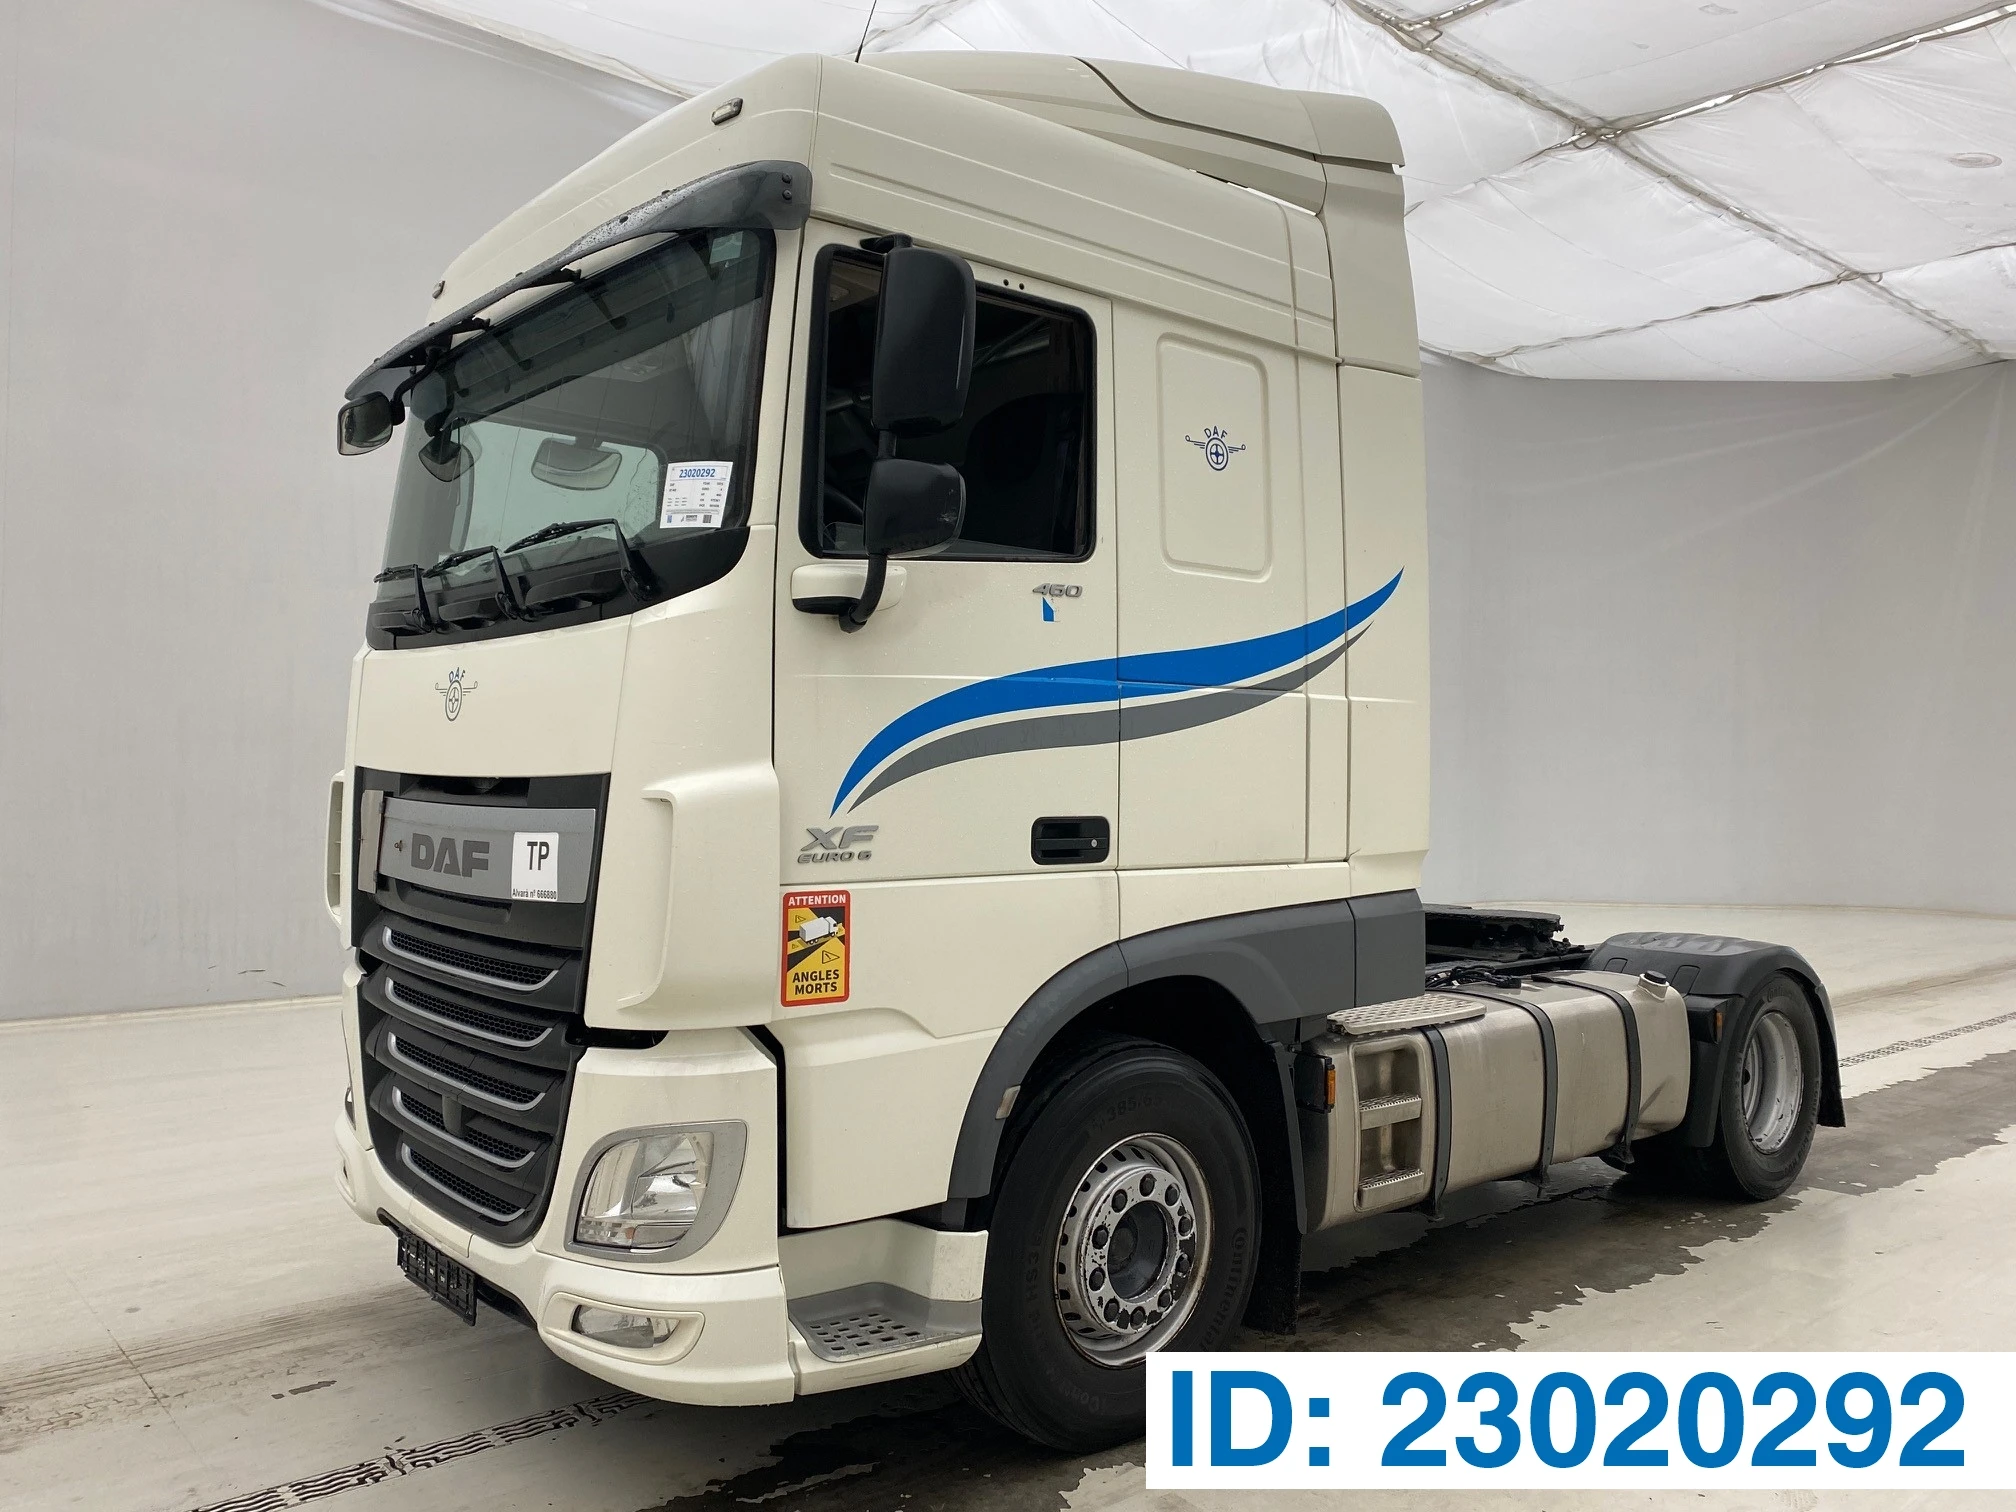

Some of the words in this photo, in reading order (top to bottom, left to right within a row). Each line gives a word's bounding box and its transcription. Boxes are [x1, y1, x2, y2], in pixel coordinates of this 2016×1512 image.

[1204, 426, 1228, 439] DAF
[679, 468, 716, 478] 23020292
[1032, 582, 1083, 598] 460
[449, 667, 466, 682] DAF
[801, 825, 879, 851] XF
[411, 833, 490, 878] DAF
[526, 841, 549, 870] TP
[797, 850, 855, 864] EURO
[857, 850, 872, 861] 6
[788, 894, 847, 906] ATTENTION
[792, 969, 840, 983] ANGLES
[794, 982, 838, 996] MORTS
